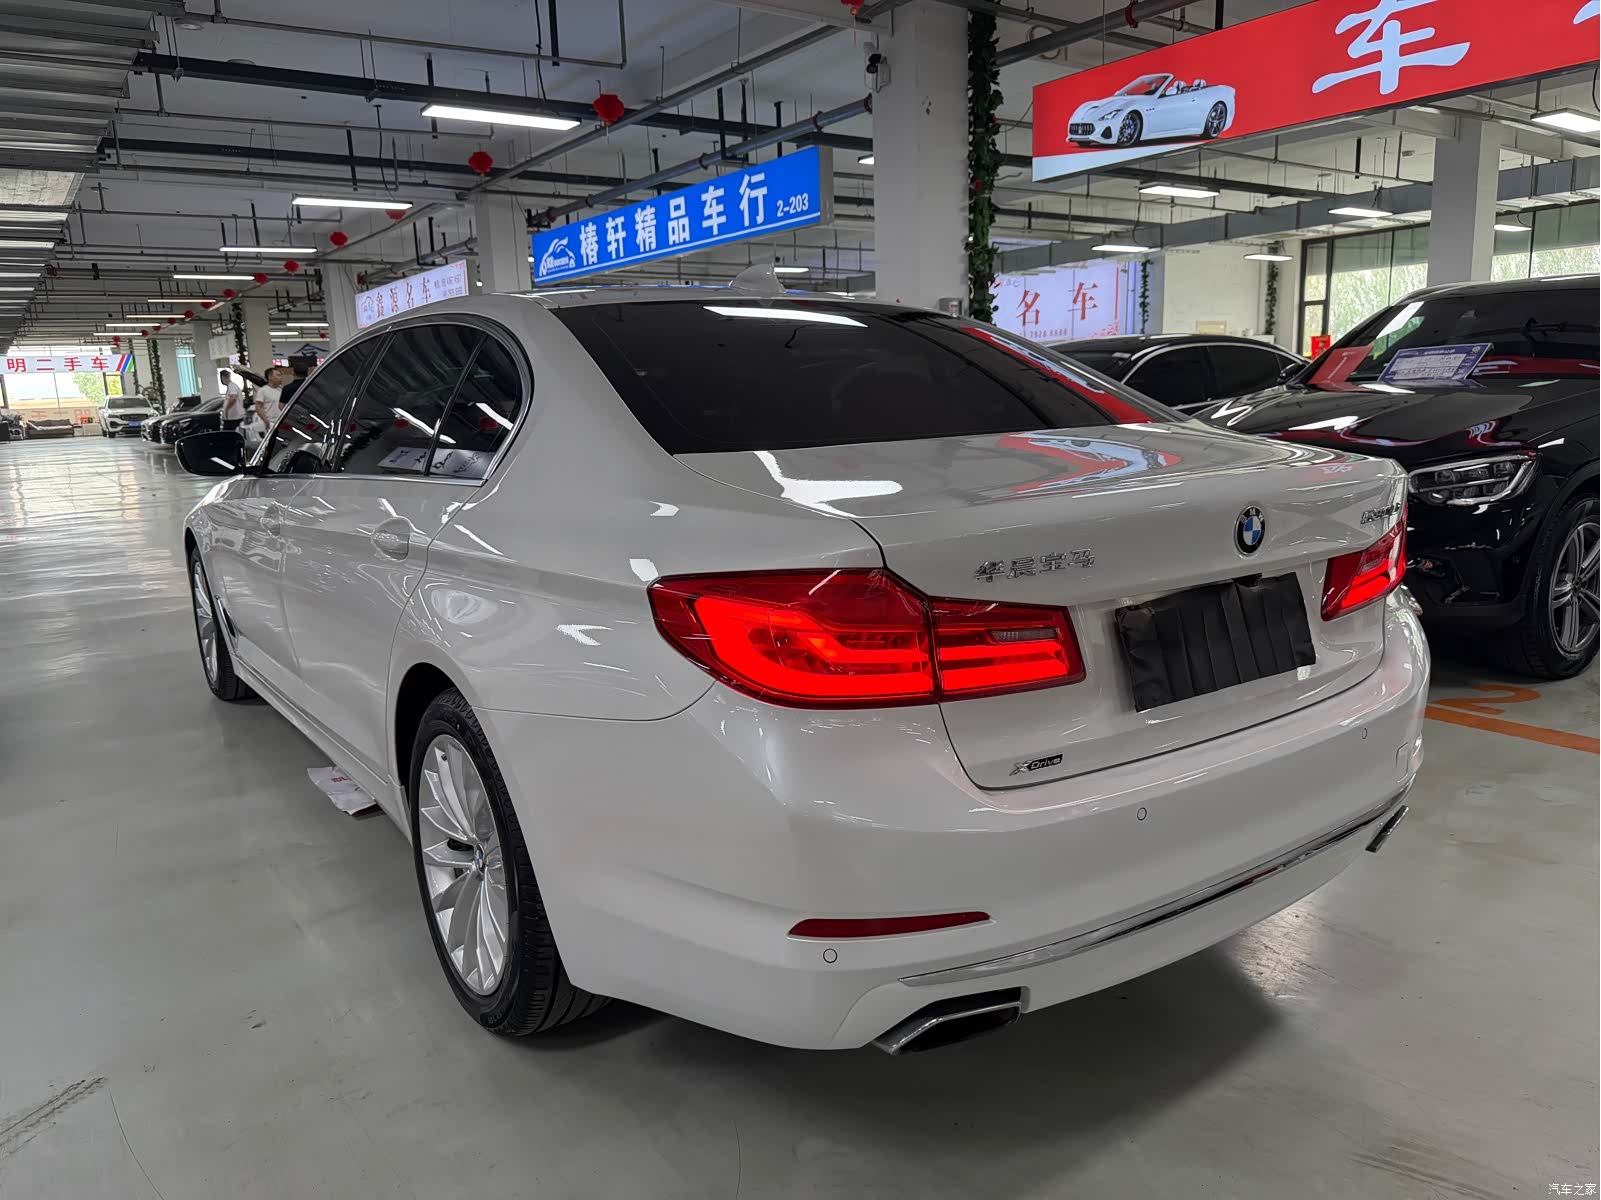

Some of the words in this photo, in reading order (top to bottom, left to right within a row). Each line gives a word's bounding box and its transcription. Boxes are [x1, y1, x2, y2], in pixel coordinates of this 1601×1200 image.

[579, 172, 768, 266] 椿轩精品车行
[777, 193, 809, 218] 2-203
[1016, 282, 1098, 327] 名车
[6, 356, 110, 373] 明二手车
[974, 548, 1095, 582] 华晨宝马
